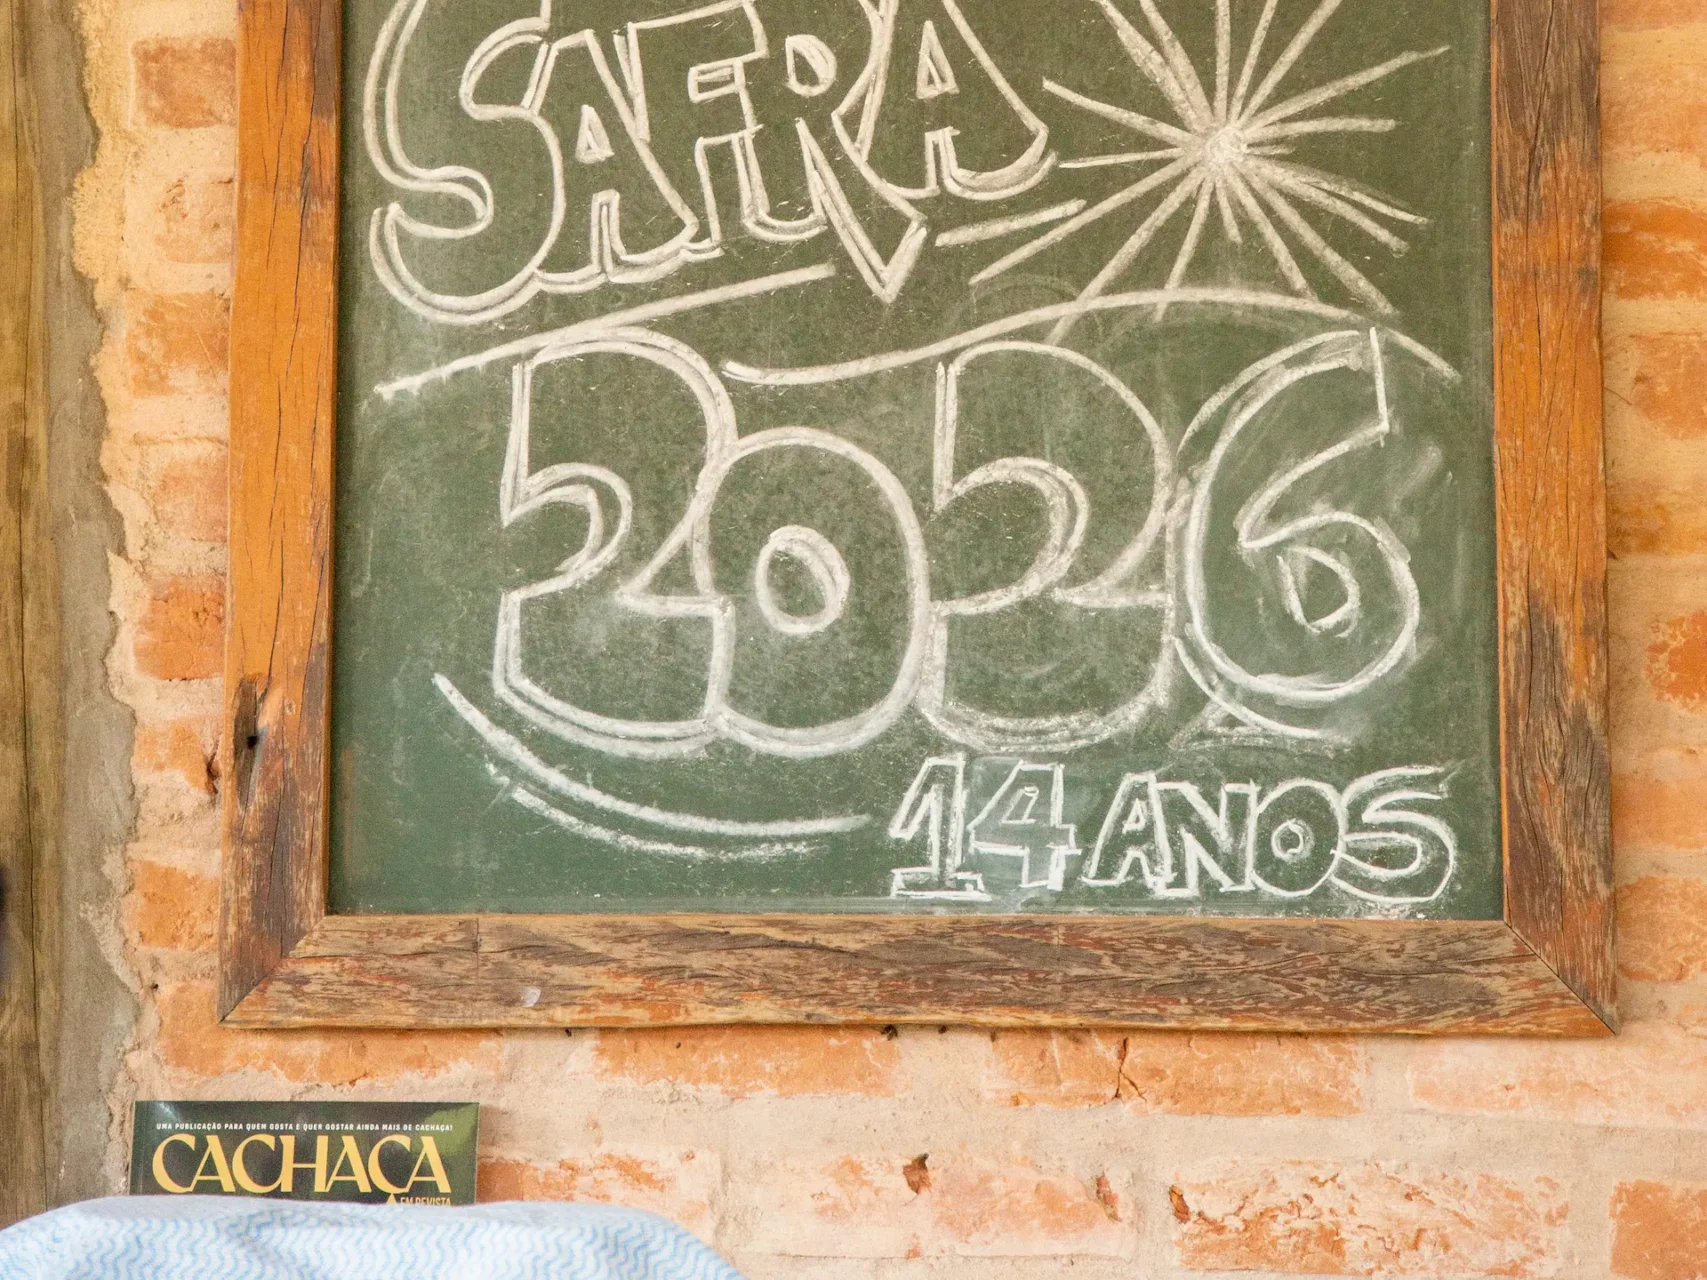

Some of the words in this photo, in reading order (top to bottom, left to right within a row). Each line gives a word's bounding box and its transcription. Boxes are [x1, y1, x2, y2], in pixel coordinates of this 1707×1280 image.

[492, 327, 1421, 758] 2026
[889, 752, 1081, 901] 14
[1081, 765, 1456, 904] ANOS
[152, 1133, 452, 1204] CACHAÇA
[175, 1122, 222, 1131] PUBLICAÇÃO
[246, 1123, 267, 1131] QUEM
[303, 1123, 323, 1131] QUER
[356, 1123, 380, 1131] AINDA
[382, 1123, 400, 1131] MAIS
[403, 1123, 412, 1131] DE
[415, 1123, 453, 1132] CACHAÇA!
